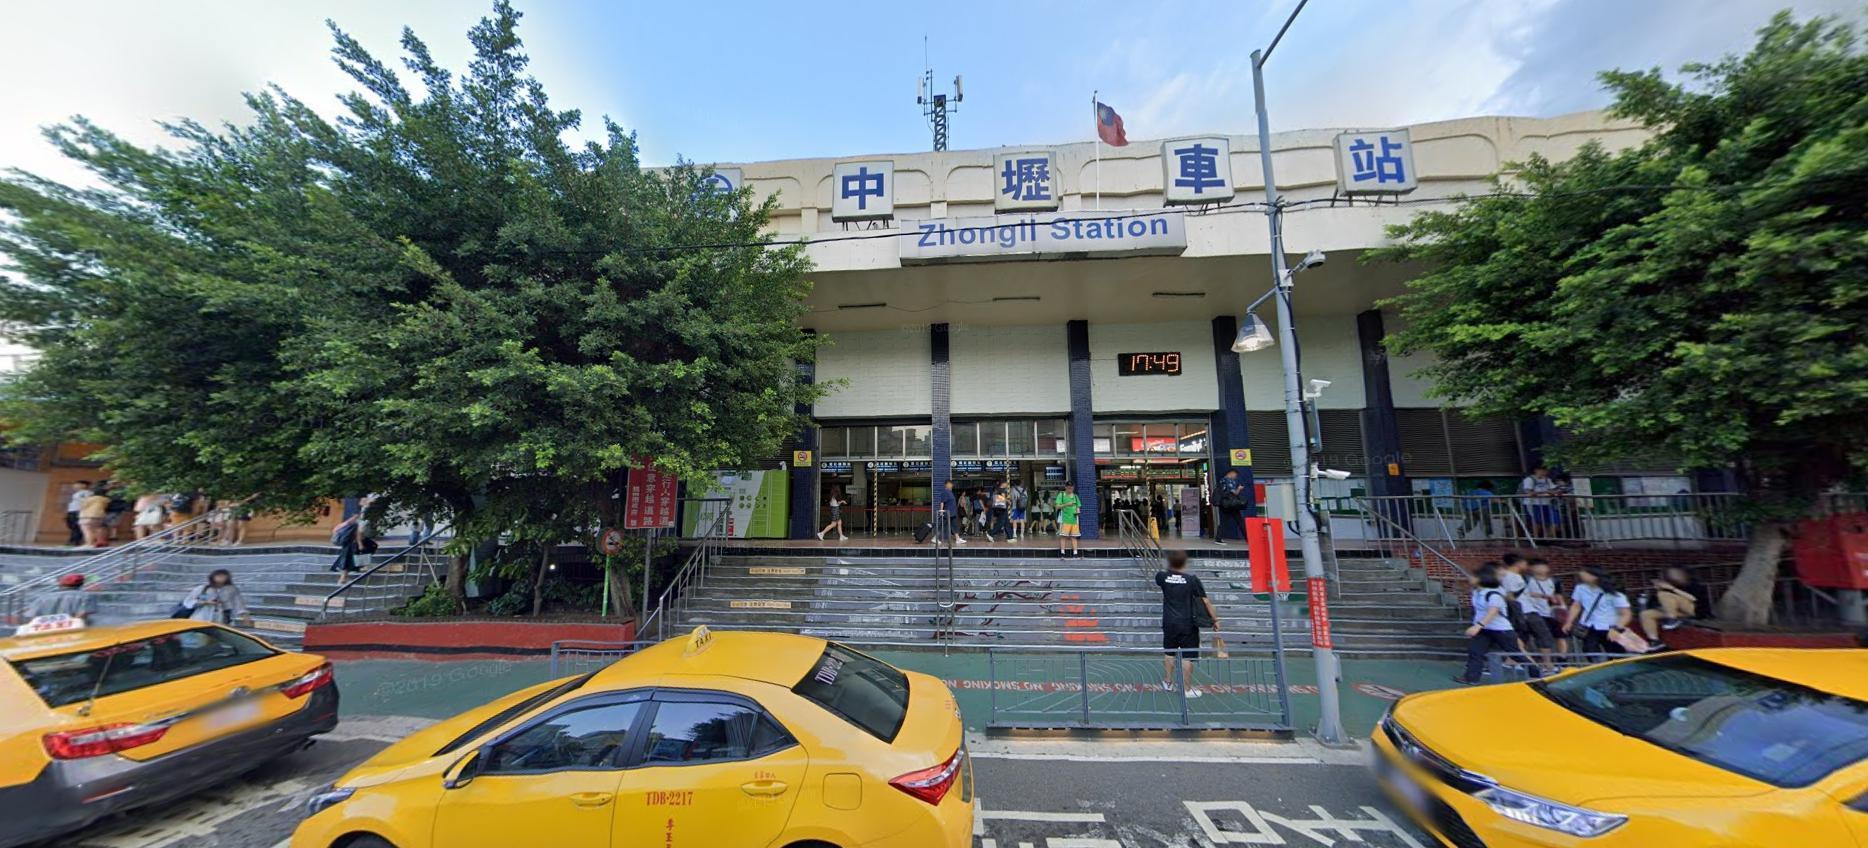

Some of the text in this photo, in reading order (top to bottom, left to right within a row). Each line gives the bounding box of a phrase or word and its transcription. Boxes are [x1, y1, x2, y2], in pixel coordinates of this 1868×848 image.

[840, 136, 1408, 210] 中壢車站
[917, 217, 1169, 249] Zhongli Station
[1132, 354, 1179, 372] 17:49
[695, 632, 712, 648] TAXI
[963, 680, 1020, 690] SMOKING
